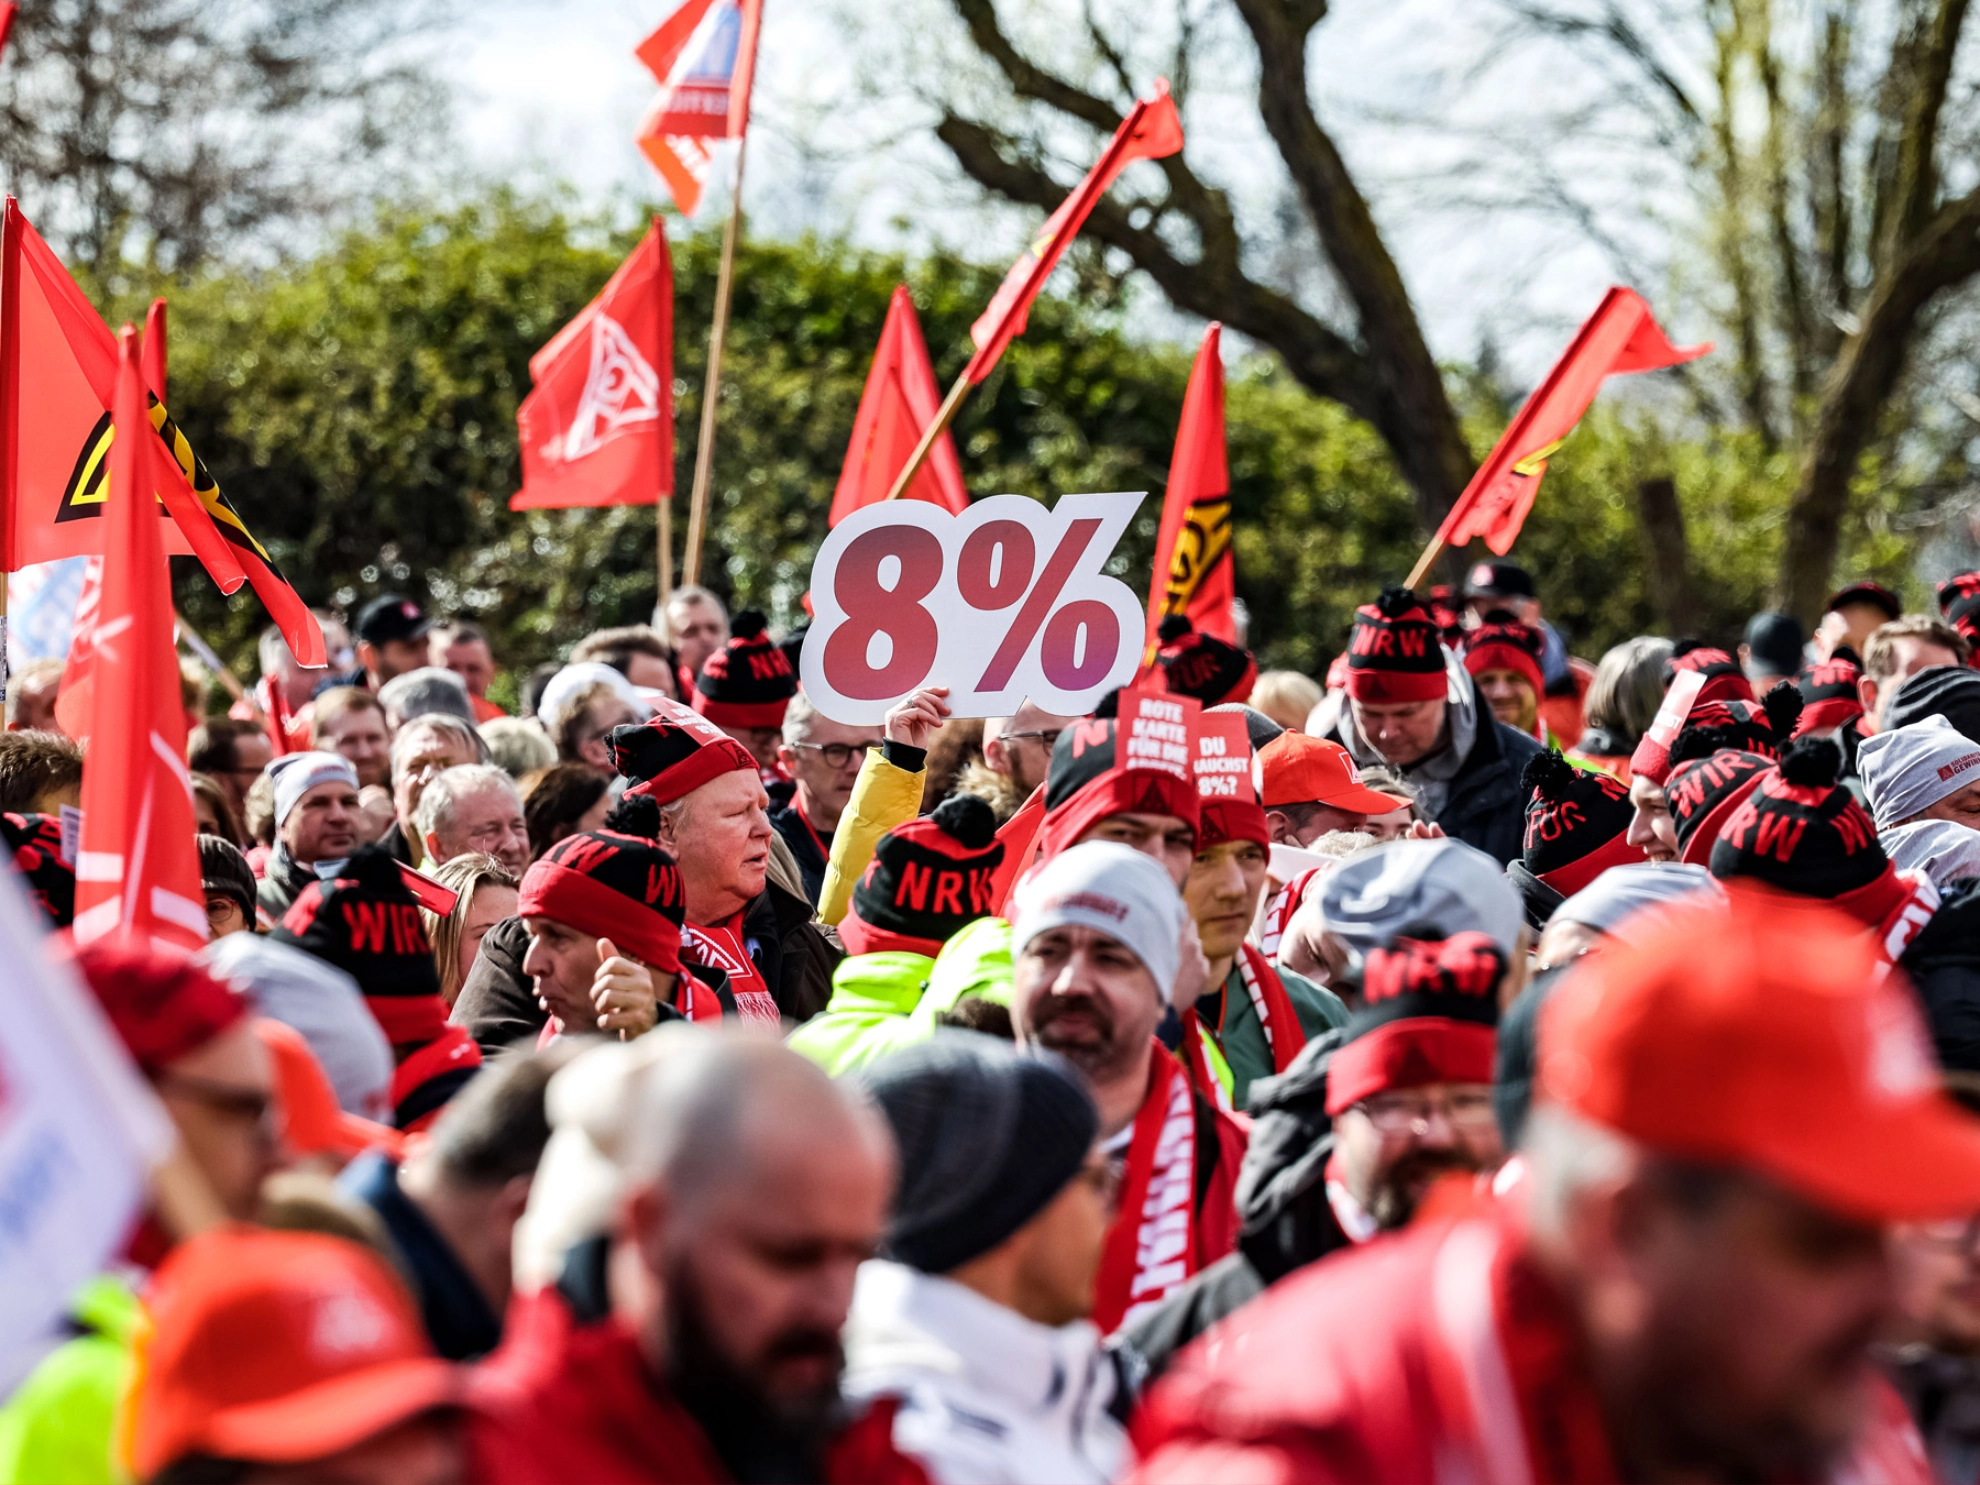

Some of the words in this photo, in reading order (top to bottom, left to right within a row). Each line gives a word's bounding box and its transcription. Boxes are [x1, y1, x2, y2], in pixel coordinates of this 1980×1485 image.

[823, 518, 1120, 700] 8%
[1353, 623, 1427, 657] NRW
[748, 647, 792, 680] NR
[1139, 698, 1184, 723] ROTE
[1132, 717, 1187, 744] KARTE
[1199, 736, 1227, 756] DU
[1127, 734, 1161, 758] FÜR
[1162, 741, 1189, 765] DIE
[1193, 757, 1248, 774] AUCHST
[1198, 775, 1238, 796] 8%?
[1670, 752, 1757, 818] WIR
[1525, 801, 1587, 849] FÜR
[1719, 799, 1808, 863] RW
[342, 901, 430, 954] WIR
